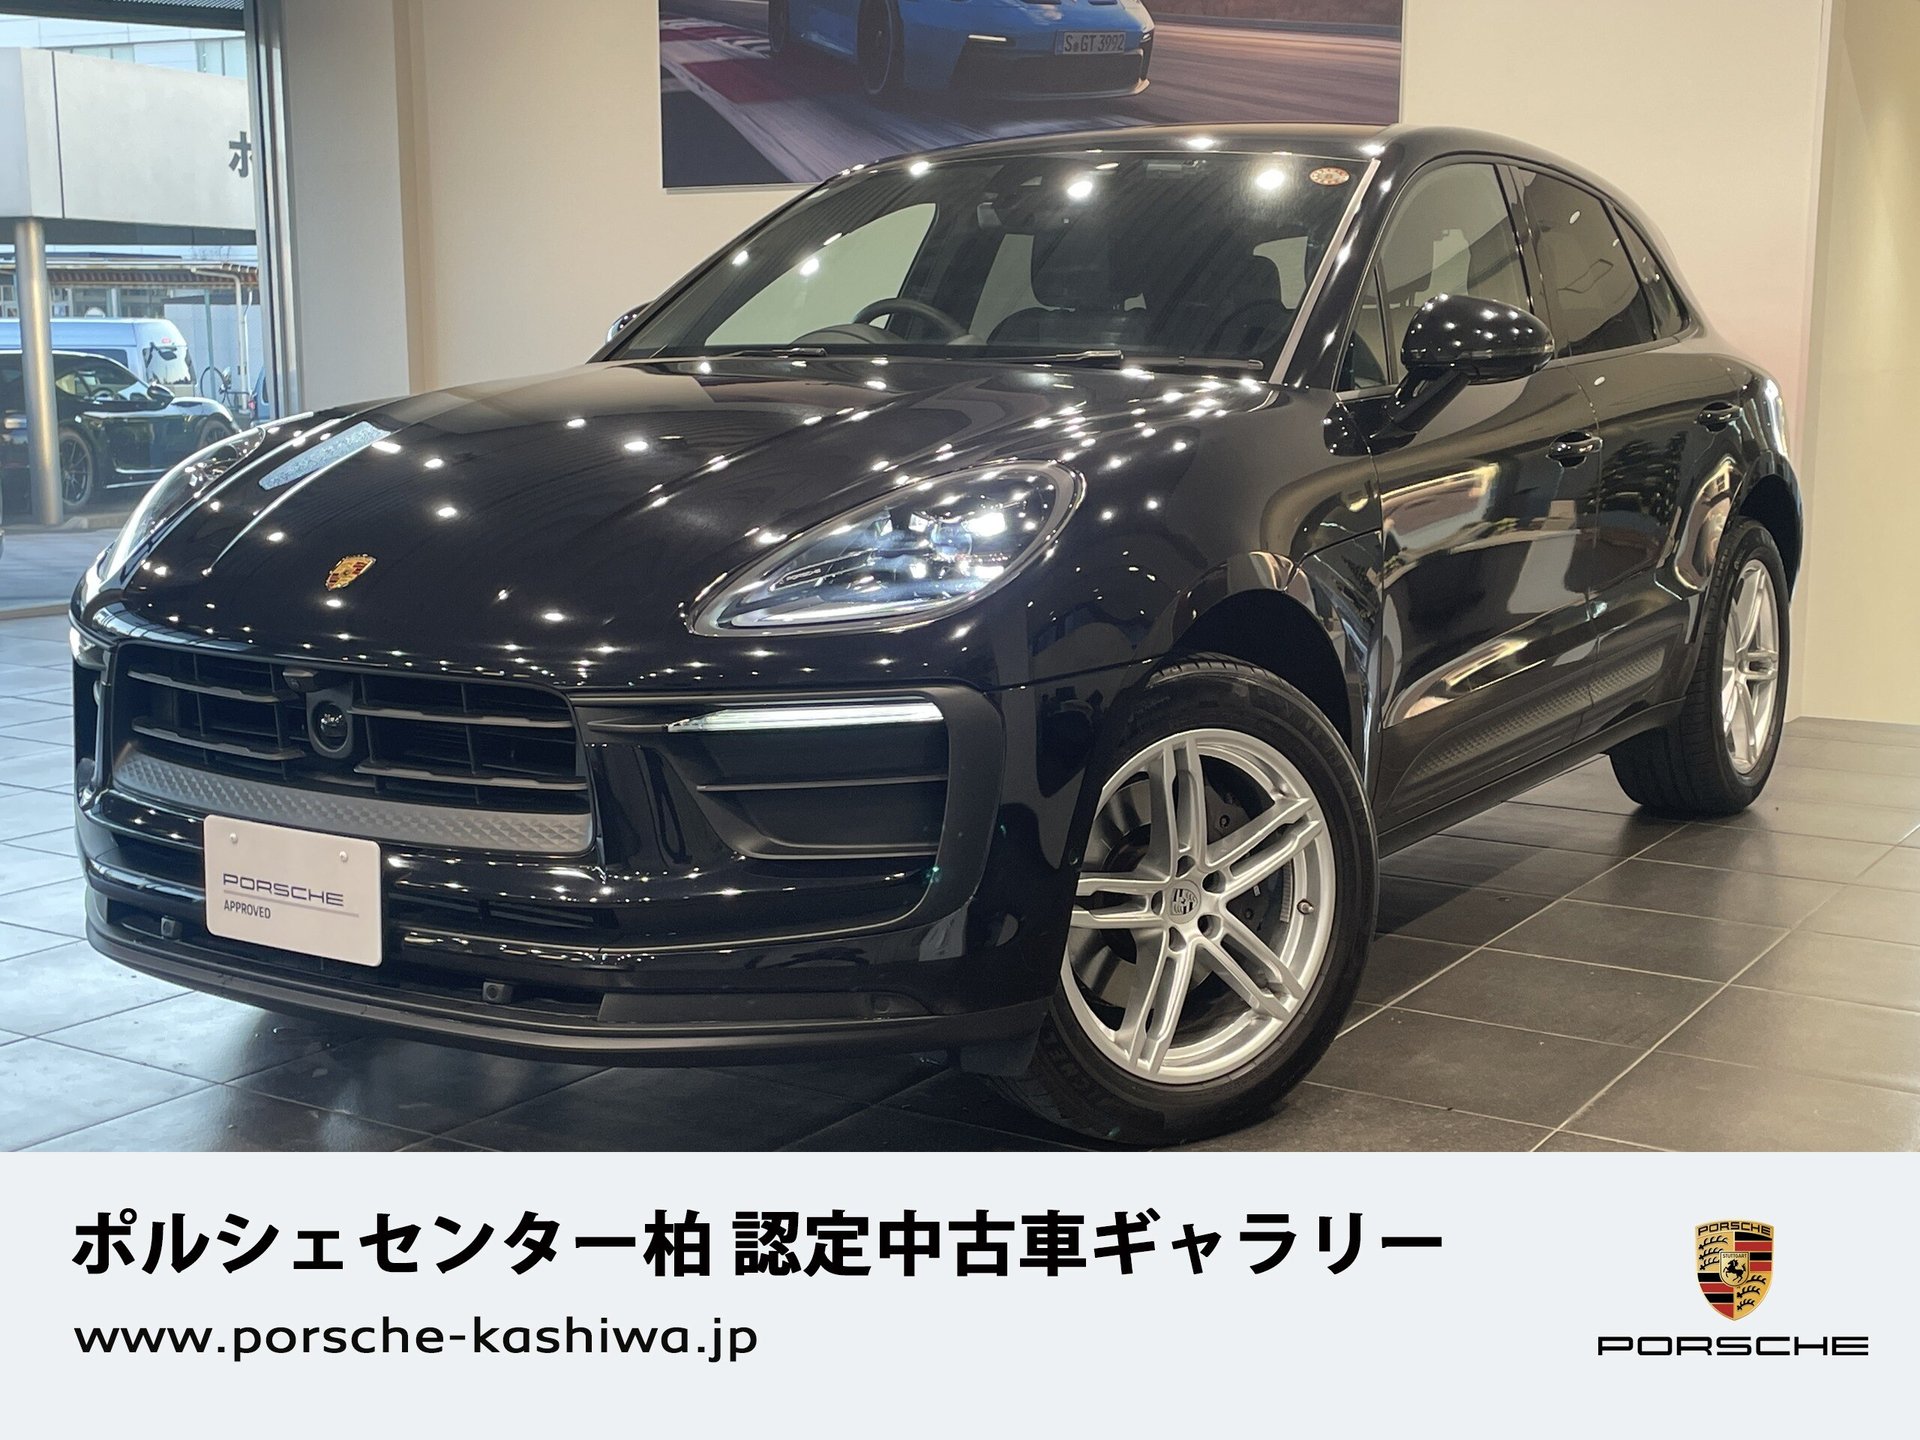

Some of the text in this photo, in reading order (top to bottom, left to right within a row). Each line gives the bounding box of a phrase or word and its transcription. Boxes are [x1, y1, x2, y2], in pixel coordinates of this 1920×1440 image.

[1081, 34, 1097, 52] GT
[1098, 34, 1125, 51] 3992
[223, 873, 344, 907] PORSCHE
[224, 899, 271, 919] APPROVED
